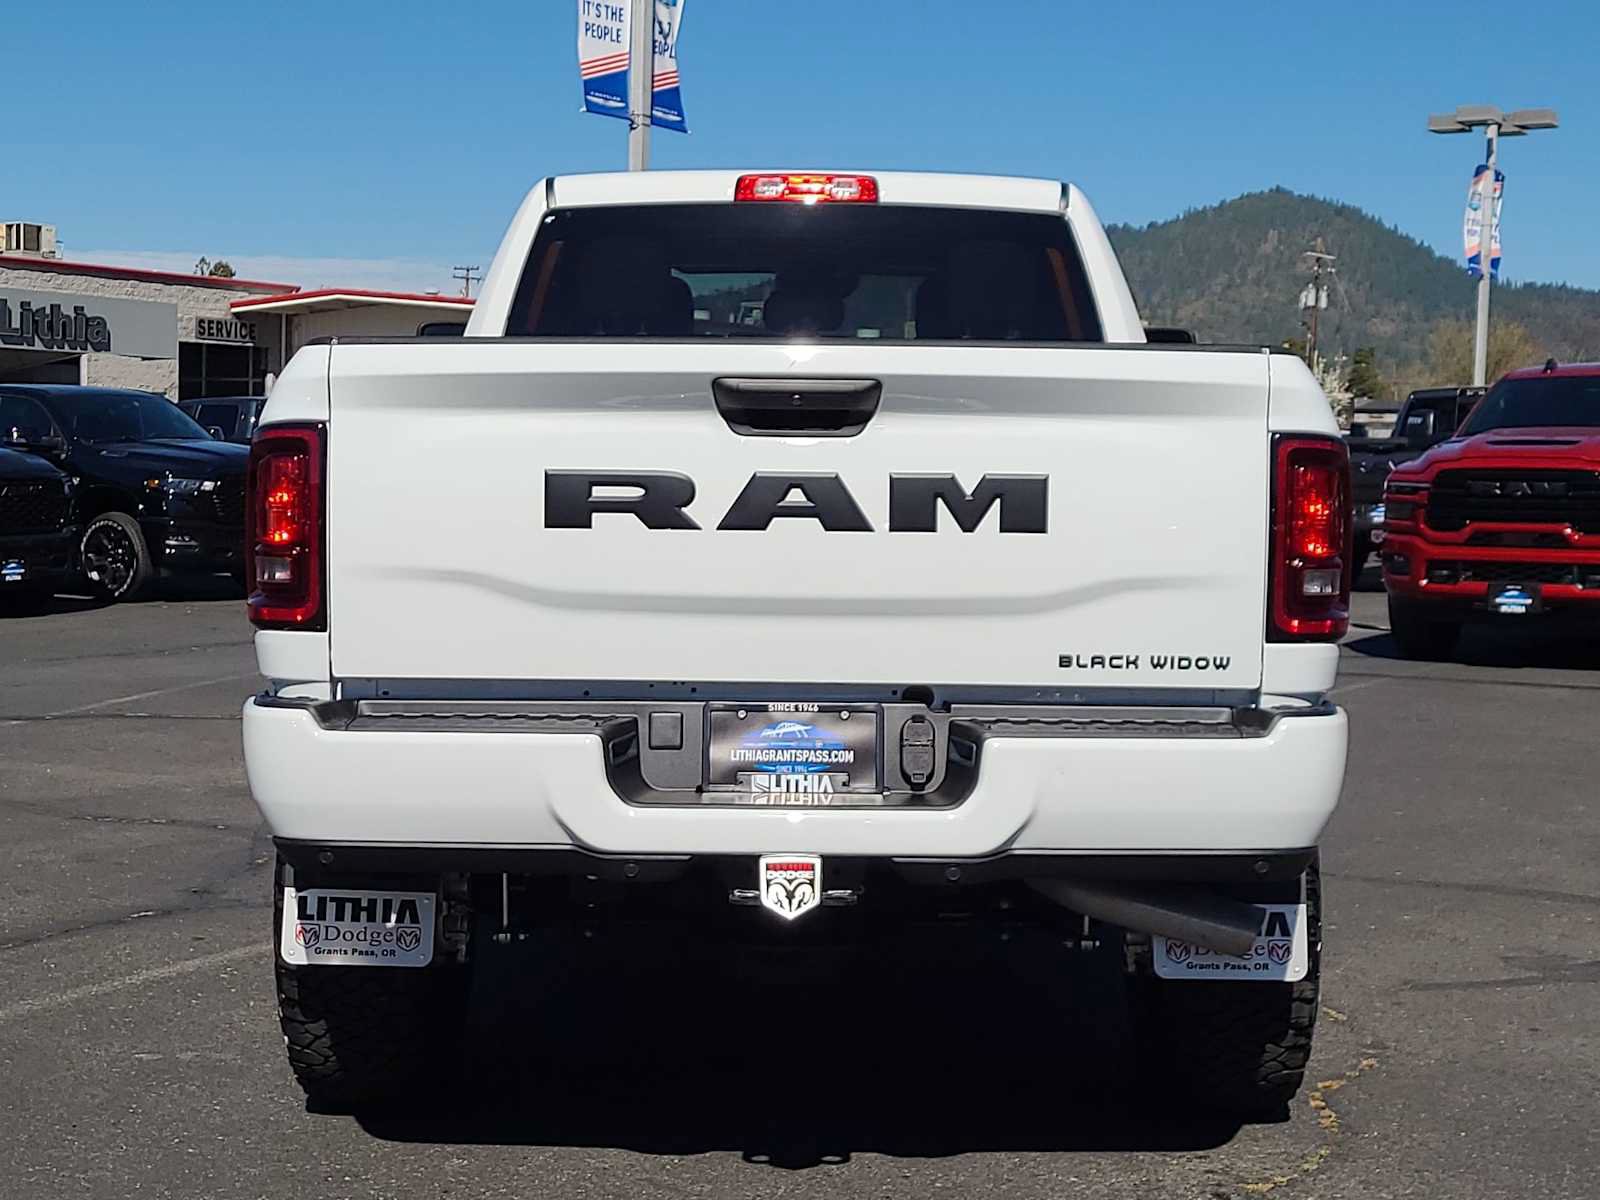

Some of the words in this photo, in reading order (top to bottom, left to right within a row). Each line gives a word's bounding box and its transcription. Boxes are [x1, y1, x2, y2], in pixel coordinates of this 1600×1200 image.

[582, 0, 602, 18] IT'S
[604, 4, 624, 23] THE
[585, 22, 622, 43] PEOPLE
[0, 298, 111, 352] Lithia
[198, 319, 257, 341] SERVICE
[544, 468, 1050, 535] RAM
[1058, 654, 1140, 669] BLACK
[1150, 655, 1231, 670] WIDOW
[768, 703, 796, 712] SINCE
[731, 749, 854, 763] LITHIAGRANTSPASS.COM
[770, 775, 834, 793] LITHIA
[766, 870, 815, 880] DODGE
[297, 895, 420, 924] LITHIA
[324, 925, 395, 947] Dodge
[314, 947, 348, 956] Grants
[352, 948, 378, 958] Pass,
[382, 949, 396, 957] OR
[1186, 961, 1220, 970] Grants
[1224, 962, 1251, 971] Pass,
[1254, 962, 1269, 971] OR
